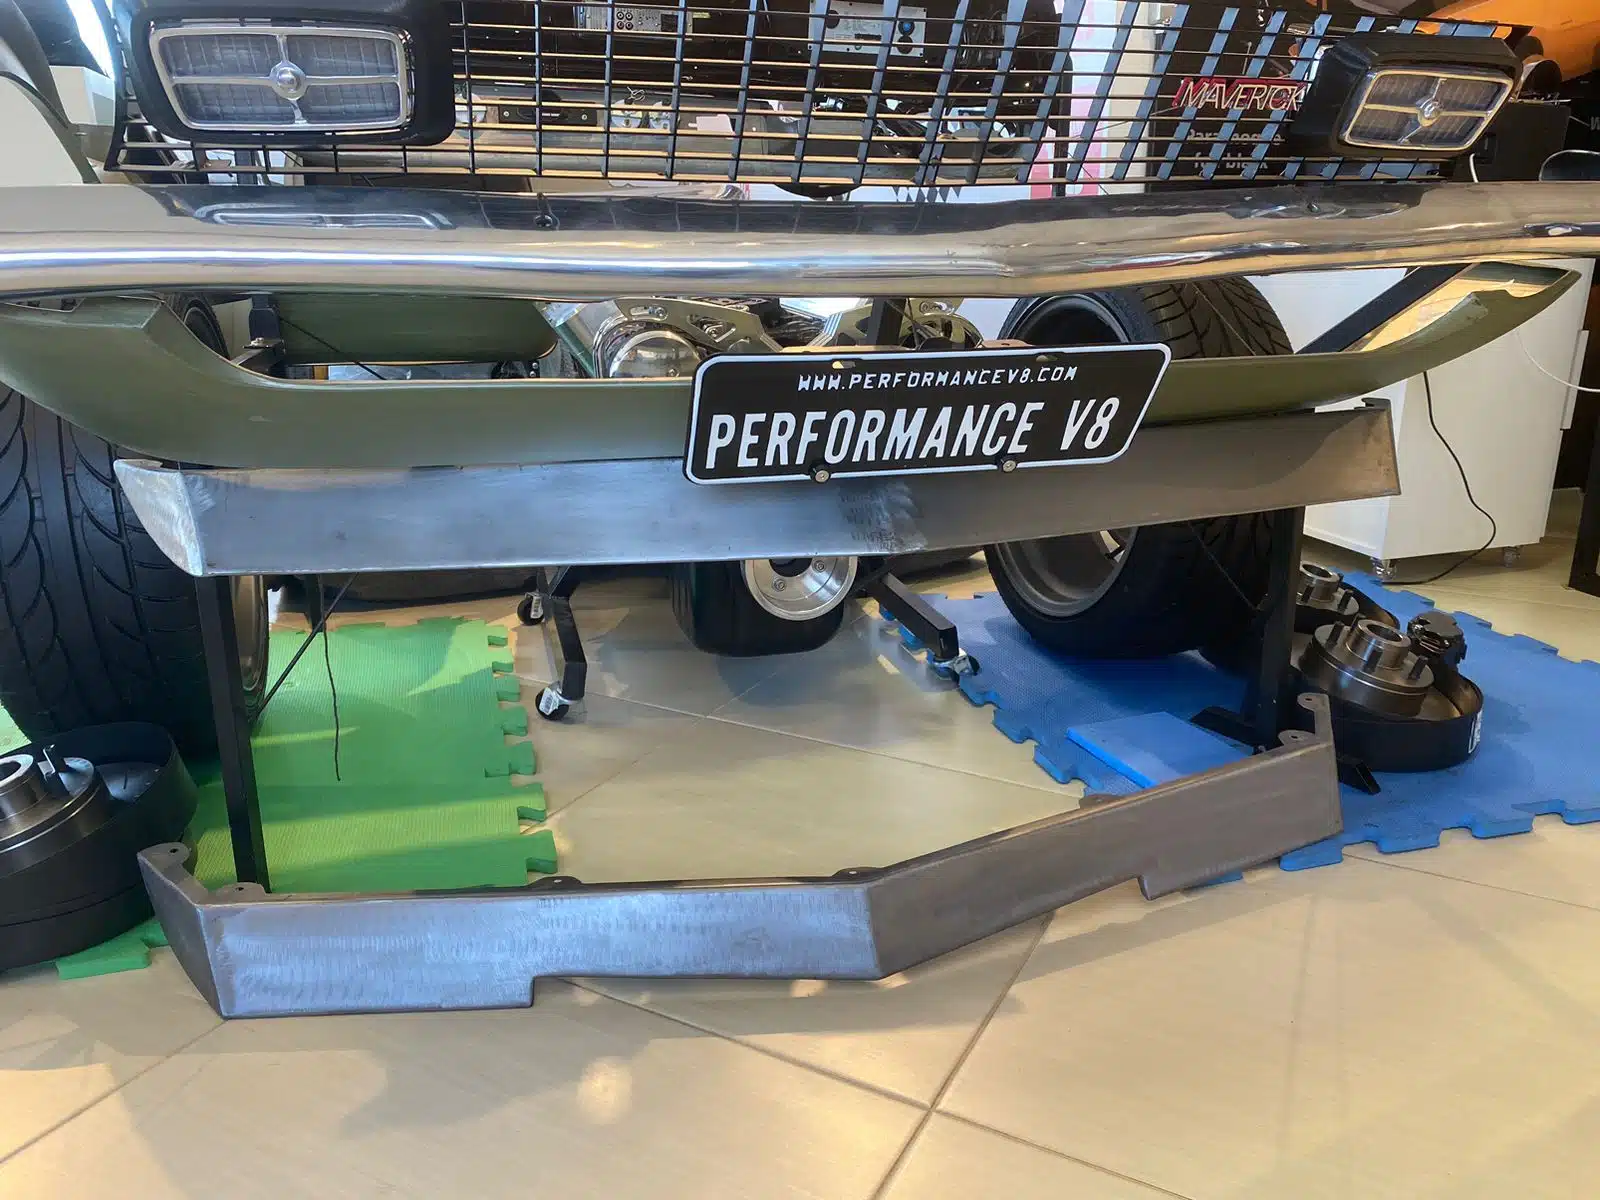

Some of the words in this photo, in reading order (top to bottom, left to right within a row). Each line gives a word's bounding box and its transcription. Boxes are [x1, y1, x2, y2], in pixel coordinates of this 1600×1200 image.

[1174, 78, 1307, 111] MAVERICK
[797, 366, 1078, 391] WWW.PERFORMANCEV8.COM
[704, 402, 1045, 469] PERFORMANCE
[1059, 396, 1120, 451] V8
